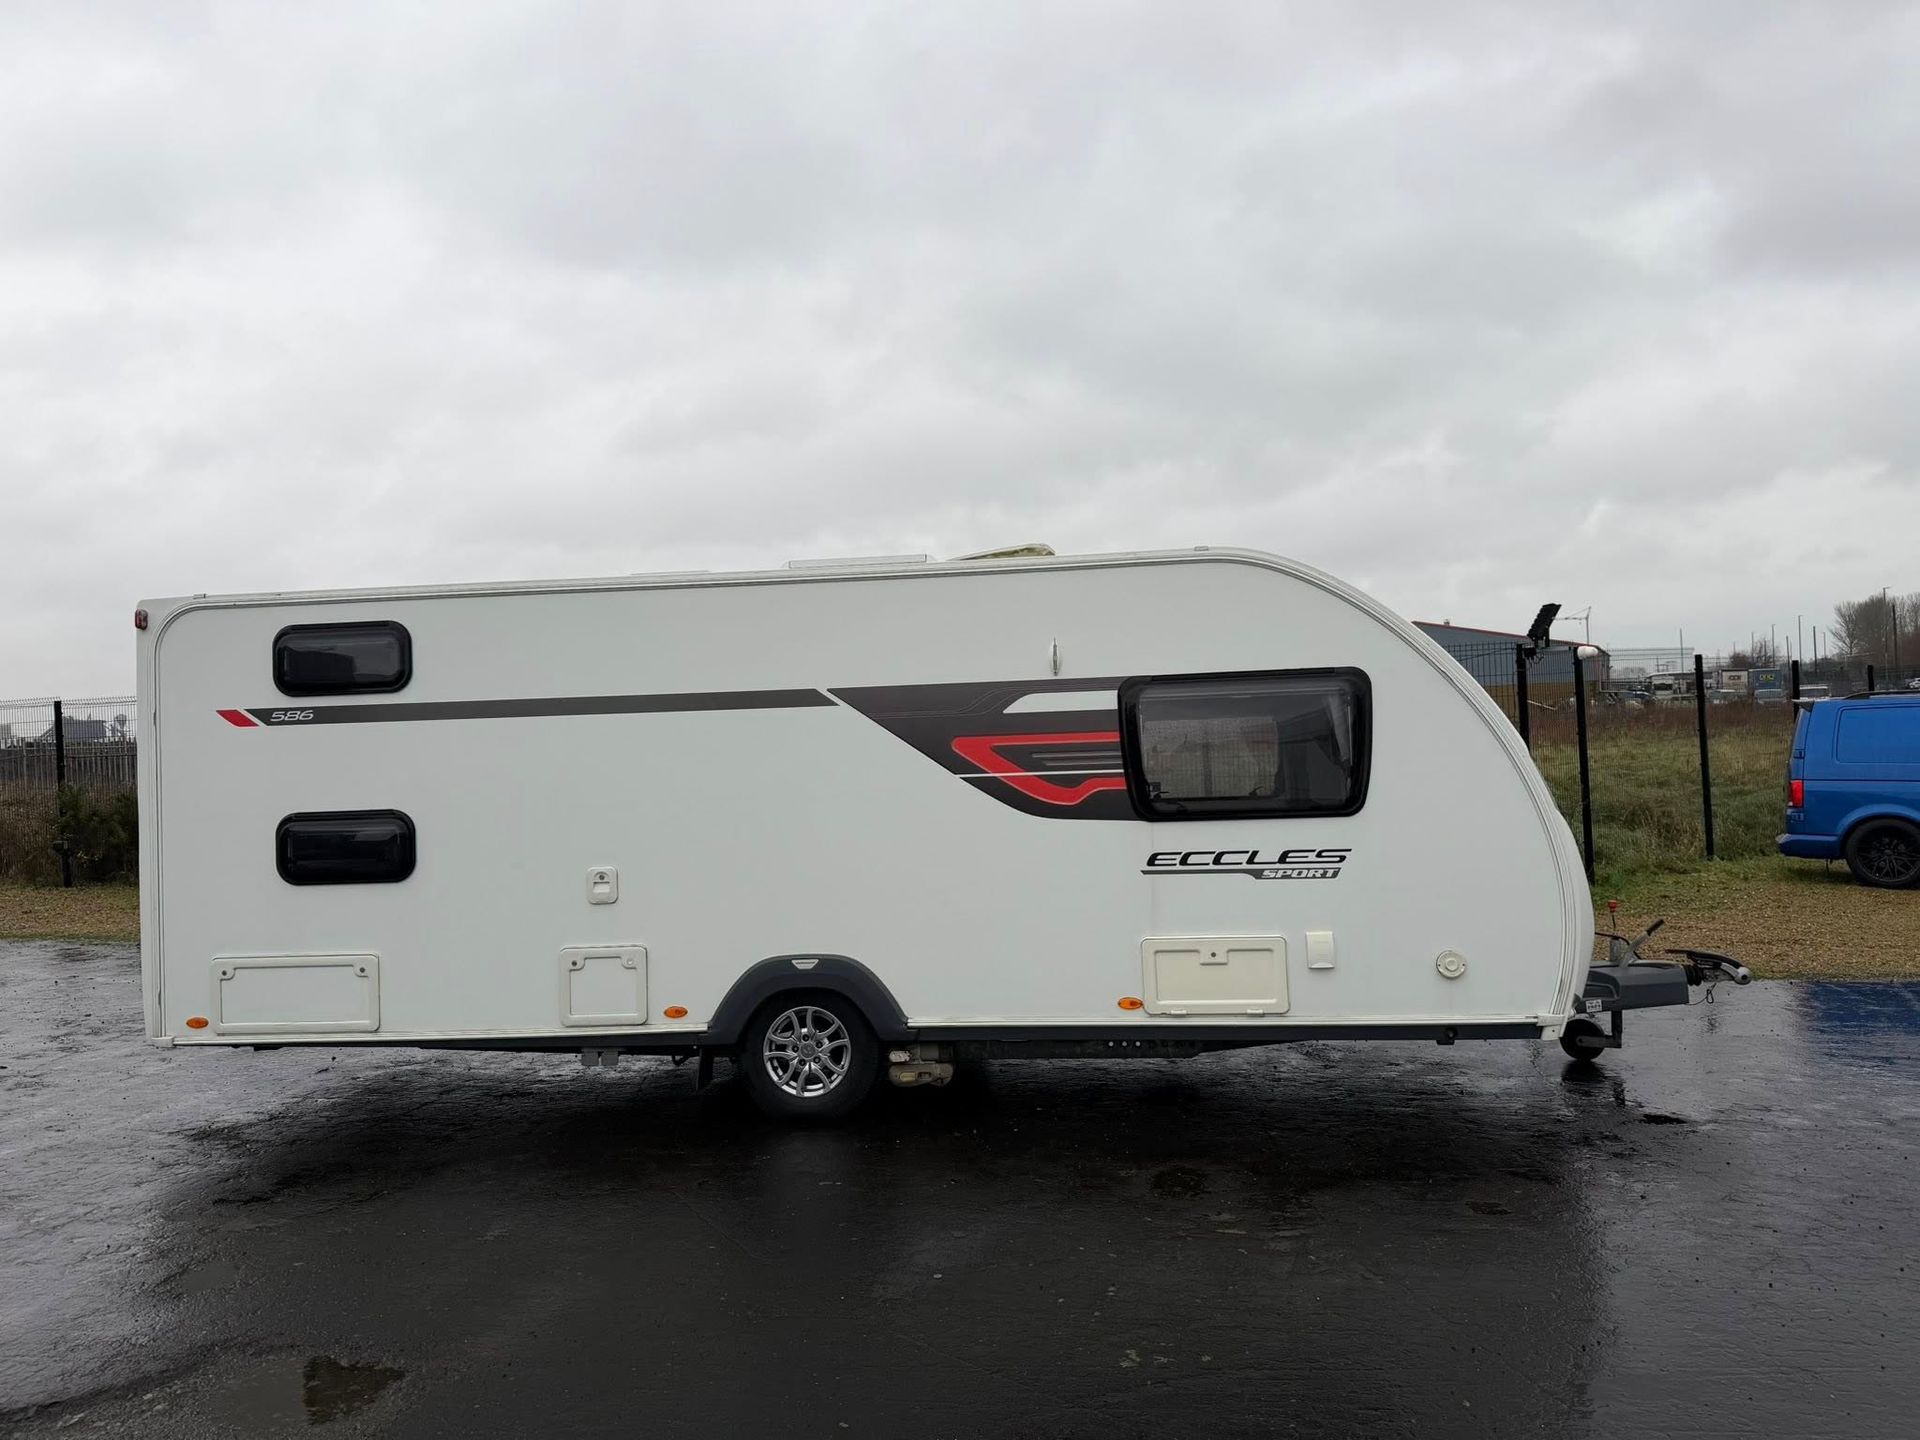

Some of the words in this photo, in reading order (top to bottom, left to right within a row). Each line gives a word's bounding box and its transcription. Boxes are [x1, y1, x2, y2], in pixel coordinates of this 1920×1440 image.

[270, 709, 314, 722] 586
[1146, 848, 1352, 867] ECCLES
[1261, 867, 1340, 879] SPORT
